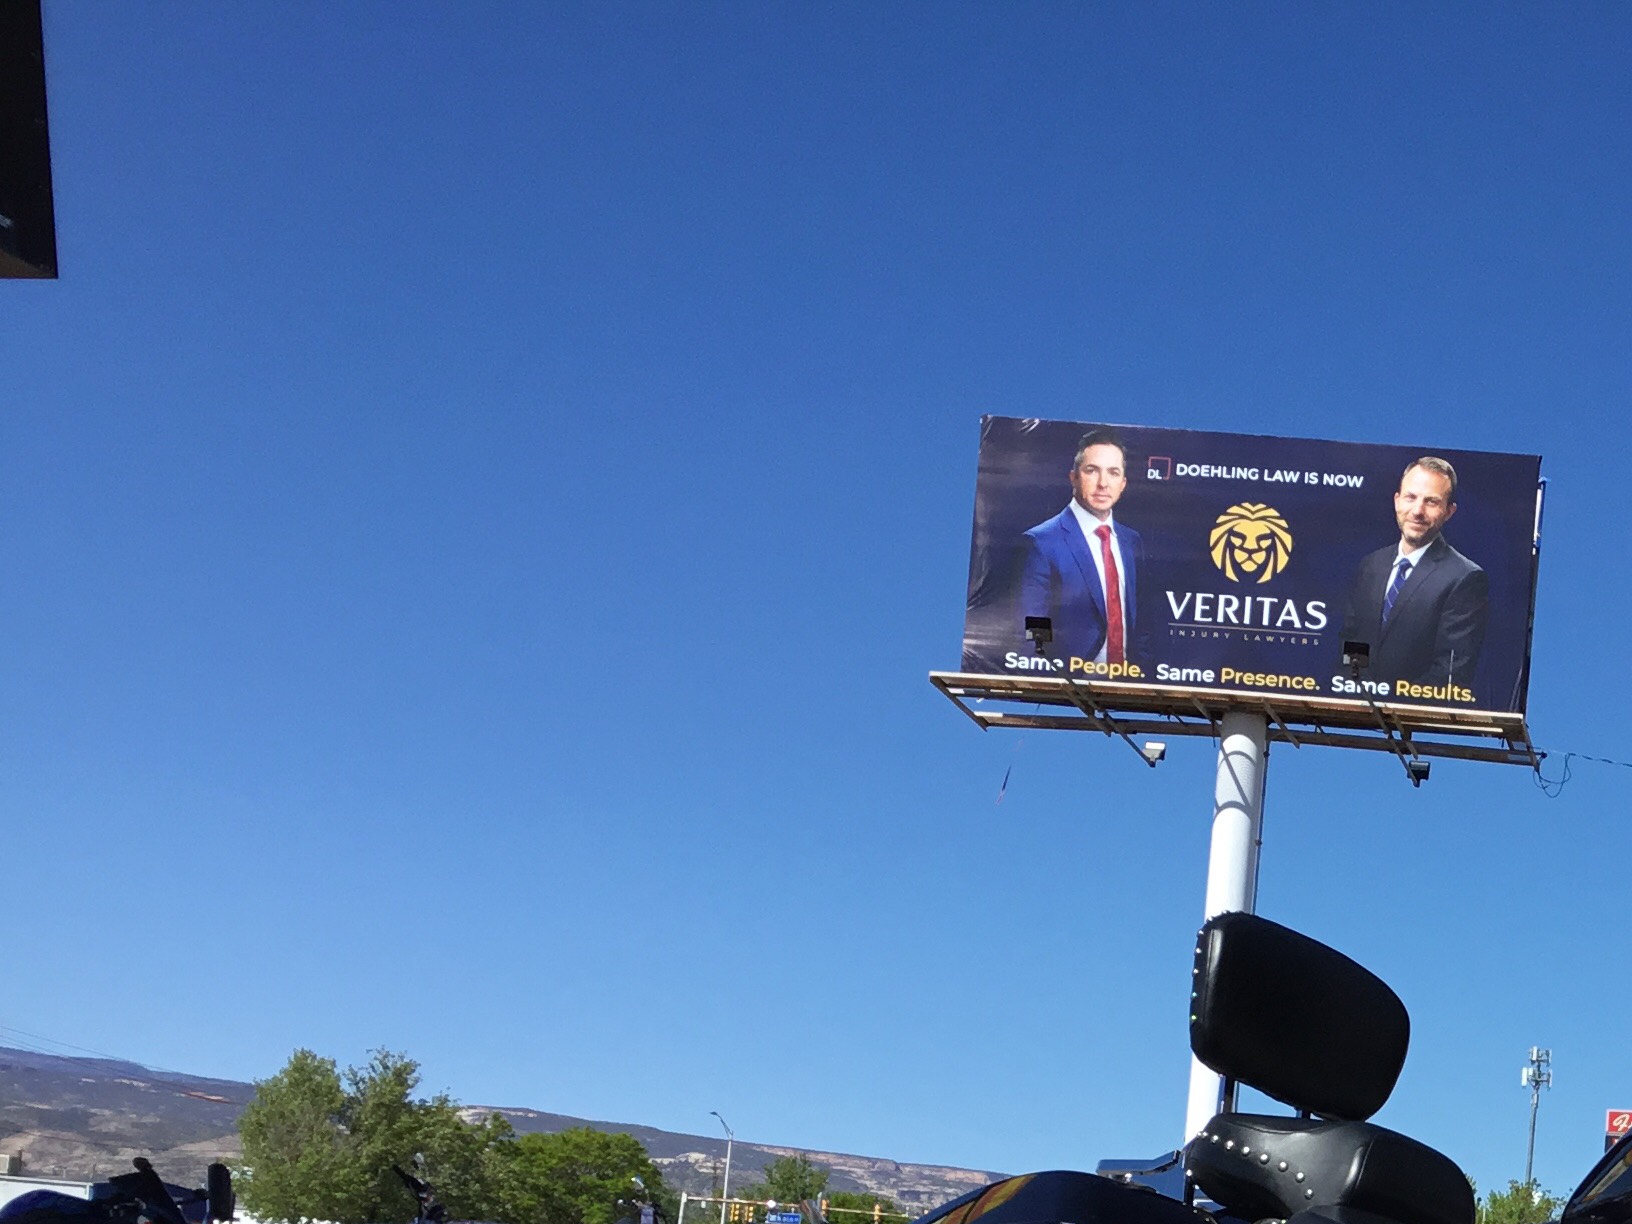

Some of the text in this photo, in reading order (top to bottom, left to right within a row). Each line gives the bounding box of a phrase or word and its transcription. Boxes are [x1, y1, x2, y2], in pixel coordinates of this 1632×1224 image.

[1147, 468, 1163, 480] DL
[1175, 463, 1365, 488] DOEHLING LAW IS NOW
[1165, 590, 1328, 630] VERITAS
[1169, 628, 1319, 646] INJURY LAWYERS
[1069, 656, 1146, 680] People.
[1156, 663, 1215, 683] Same
[1220, 667, 1320, 691] Presence.
[1331, 675, 1390, 696] Same
[1395, 680, 1476, 703] Results.
